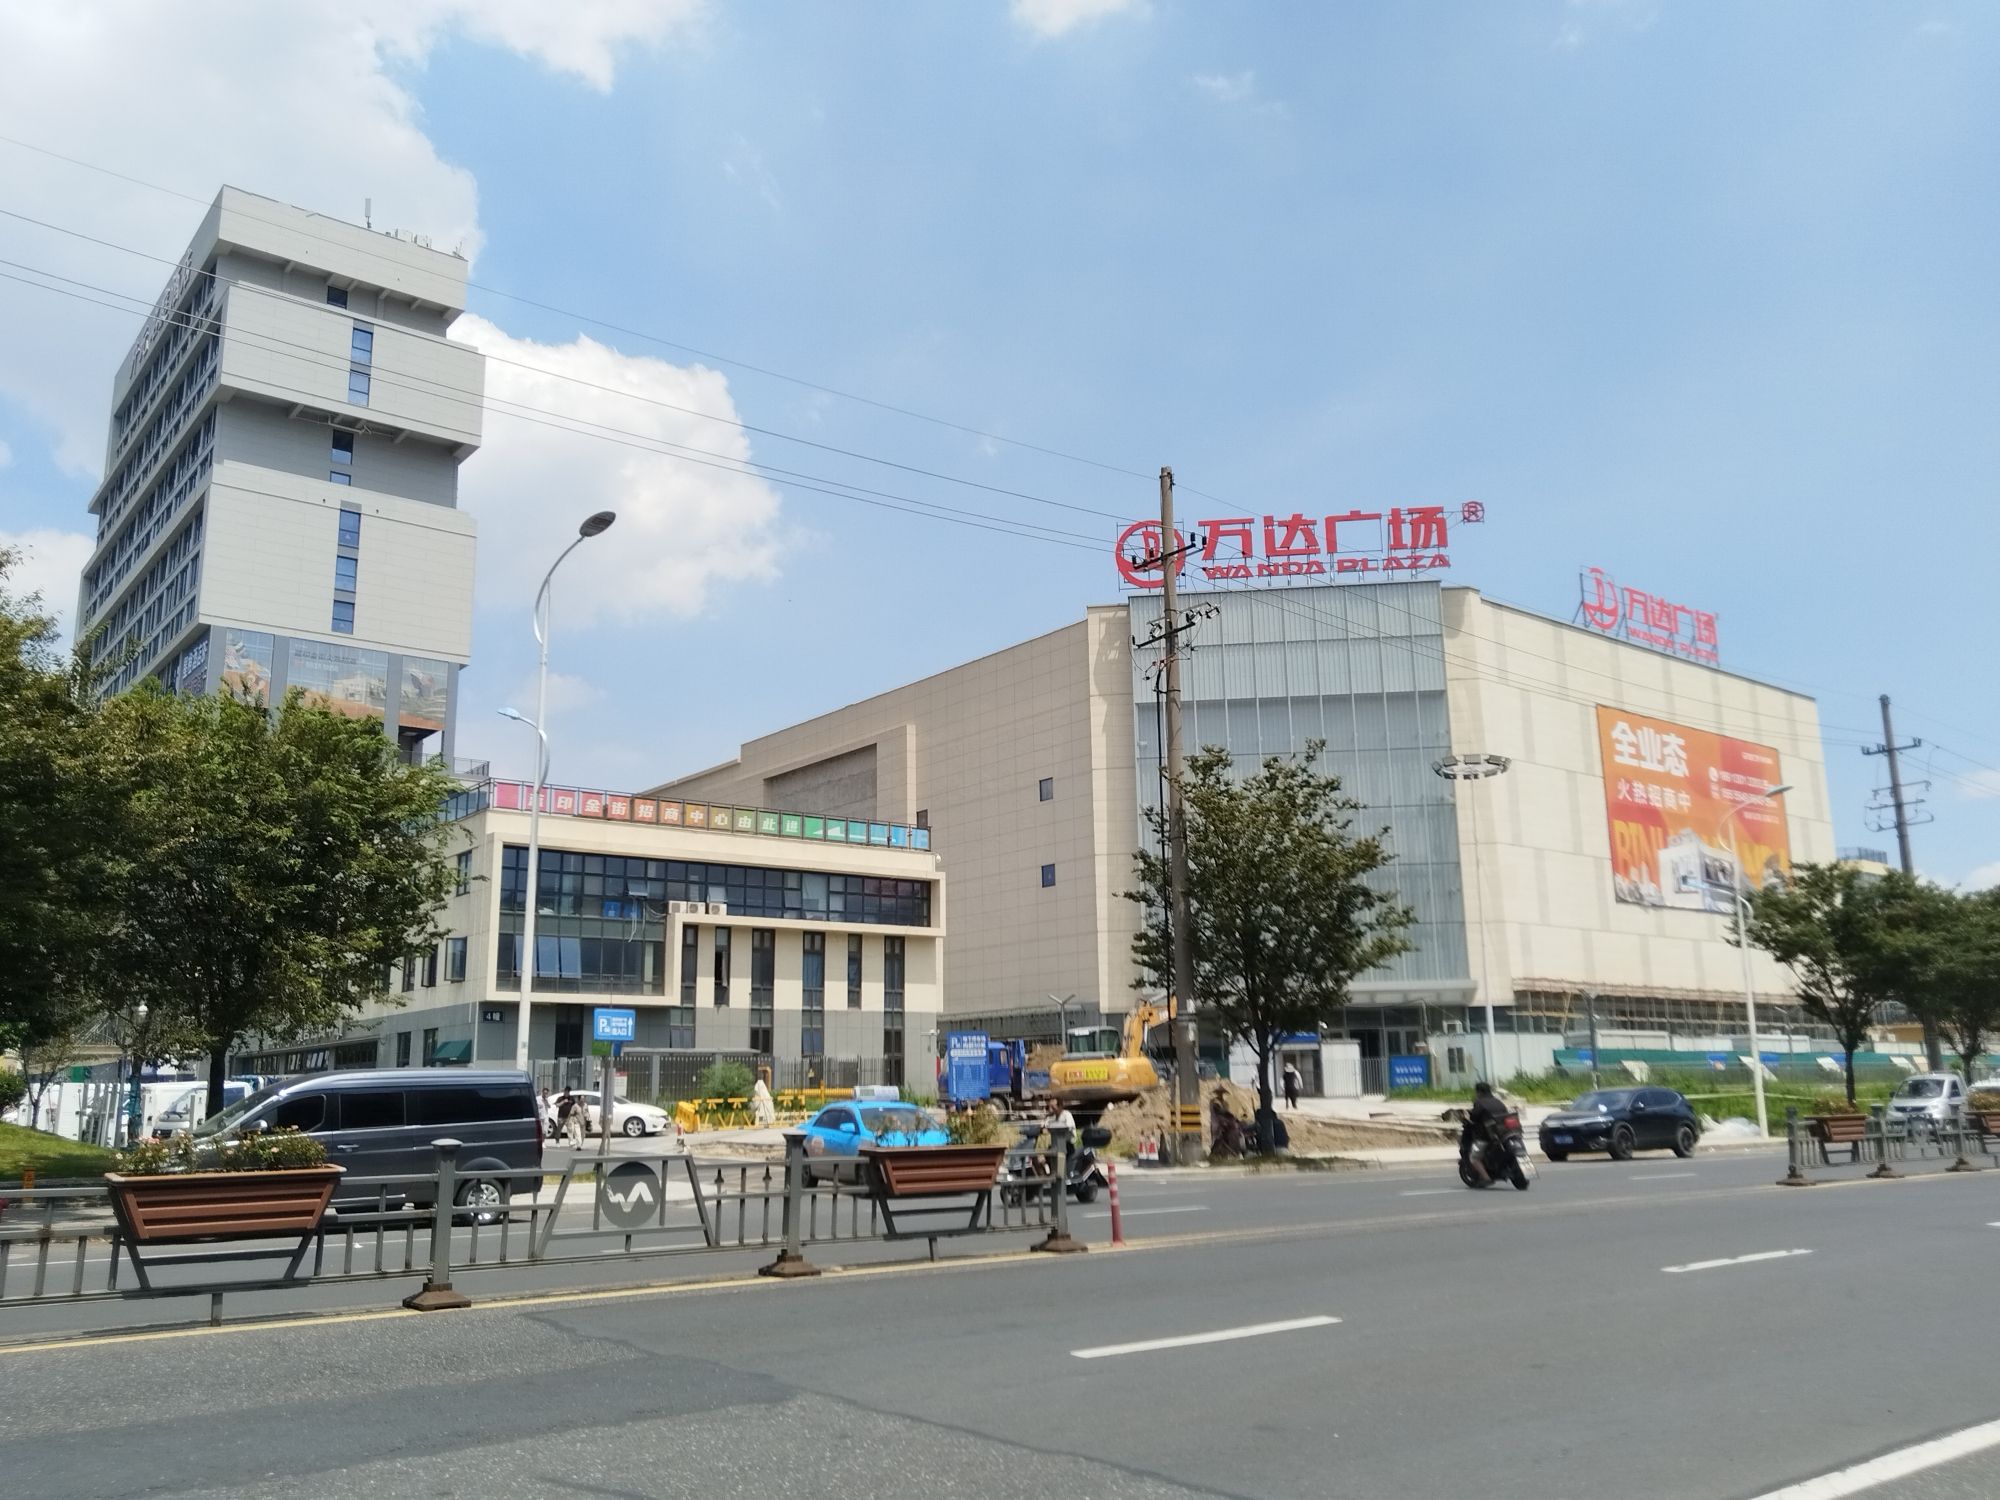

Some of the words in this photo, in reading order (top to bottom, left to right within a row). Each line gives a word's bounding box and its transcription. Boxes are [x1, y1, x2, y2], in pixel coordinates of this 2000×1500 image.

[1198, 506, 1448, 560] 万达广场
[1203, 560, 1326, 580] WANDA
[1337, 553, 1451, 573] PLAZA
[1623, 587, 1718, 646] 万达广场
[1611, 721, 1690, 777] 全业态
